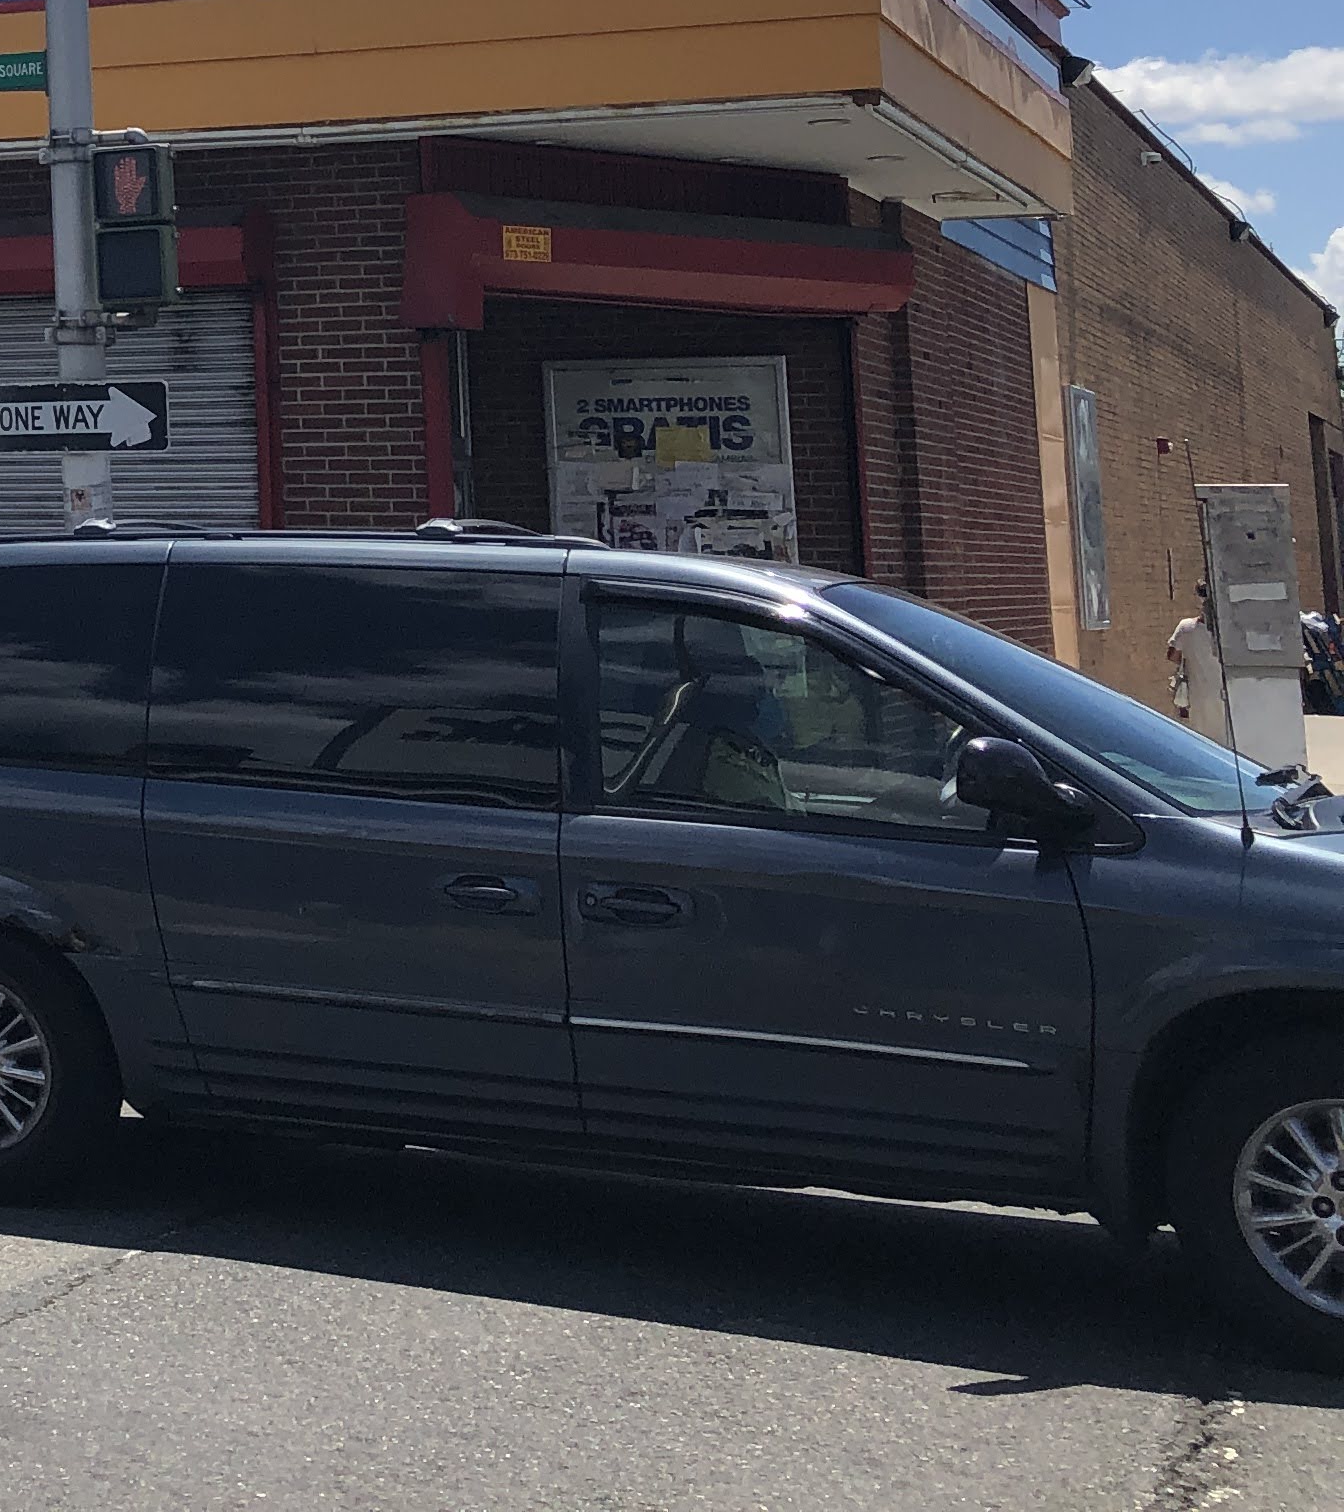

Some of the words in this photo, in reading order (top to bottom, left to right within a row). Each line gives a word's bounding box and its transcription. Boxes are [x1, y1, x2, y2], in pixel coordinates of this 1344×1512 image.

[0, 405, 44, 432] ONE
[53, 404, 104, 430] WAY
[577, 399, 589, 414] 2
[595, 395, 752, 414] SMARTPHONES
[853, 1005, 1056, 1035] CHRYSLER
